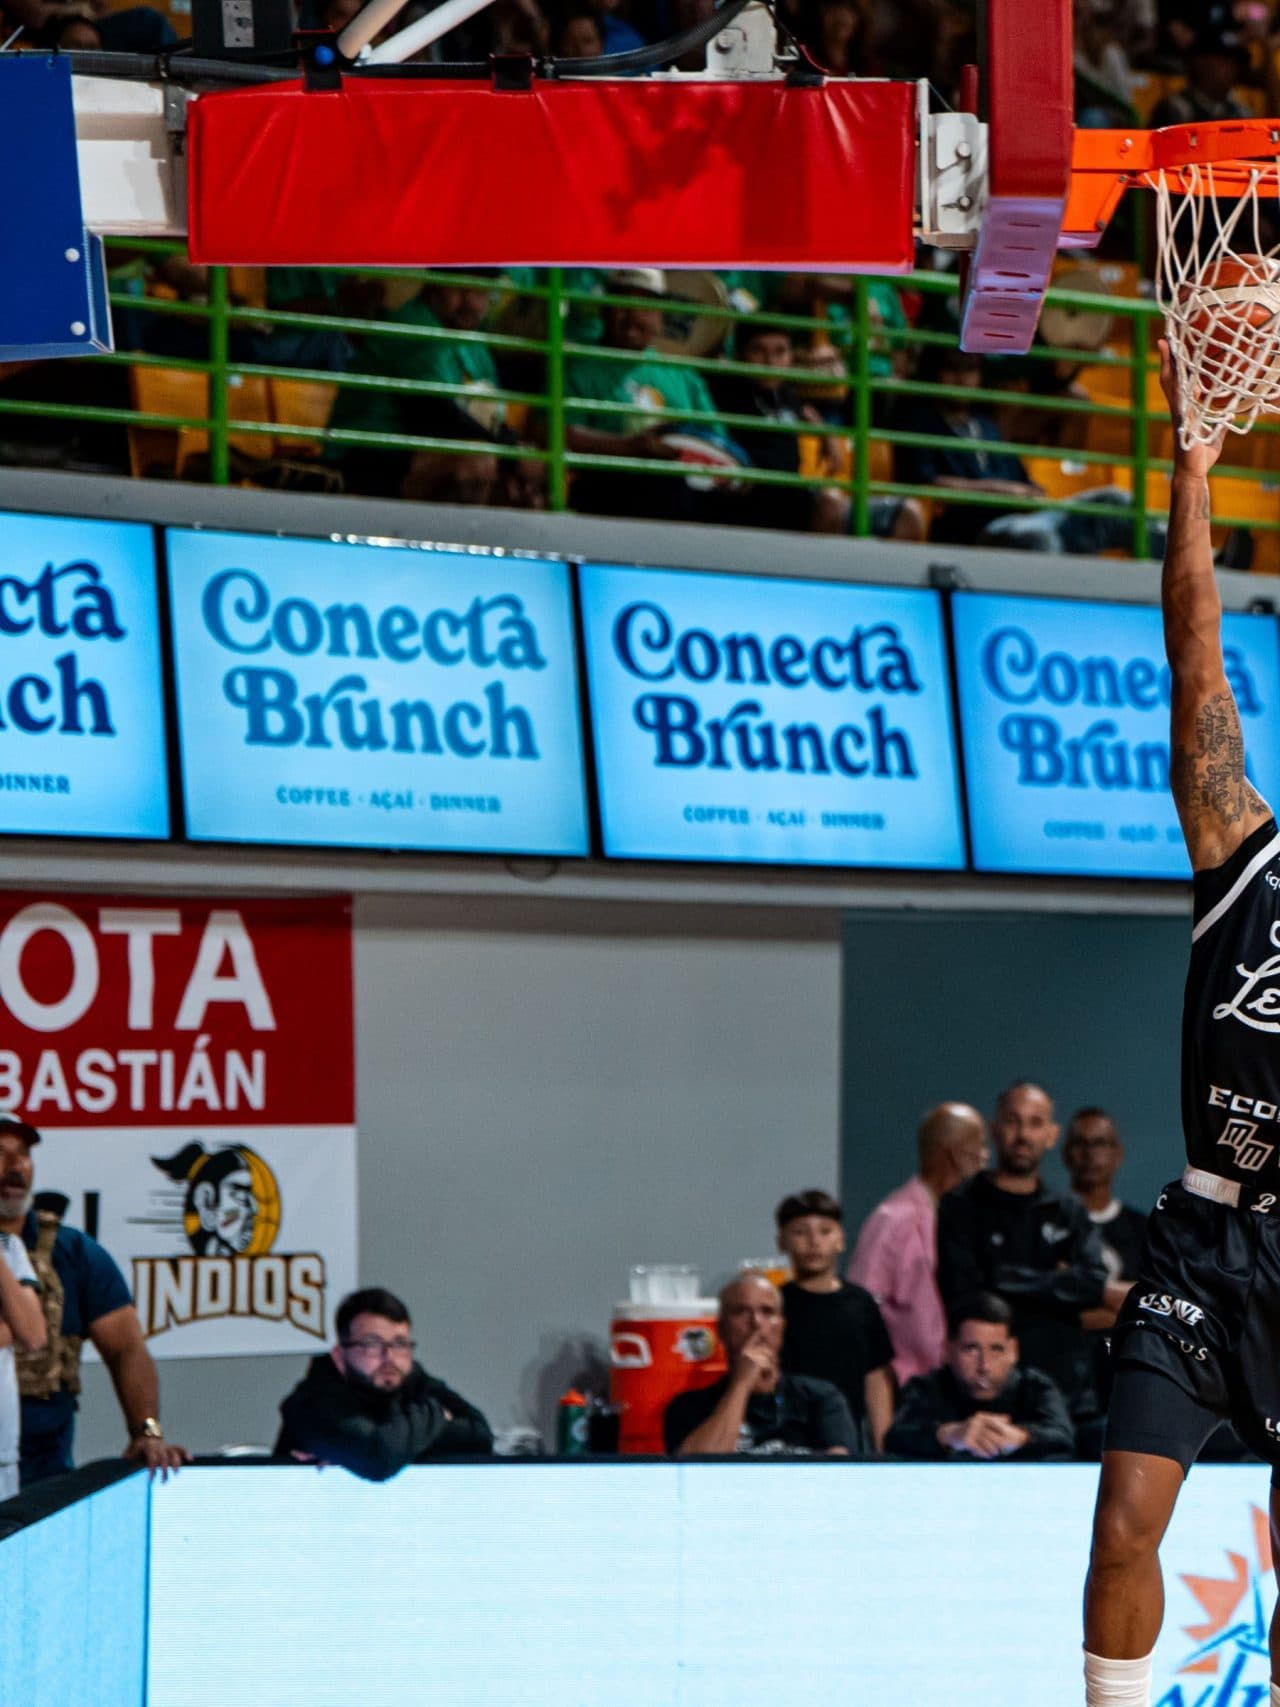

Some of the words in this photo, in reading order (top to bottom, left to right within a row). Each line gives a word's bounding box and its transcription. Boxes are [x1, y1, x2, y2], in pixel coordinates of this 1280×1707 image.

[201, 568, 547, 671] Conecta
[613, 602, 923, 695] Conecta
[0, 650, 117, 737] ch
[223, 666, 540, 761] Brunch
[981, 625, 1263, 717] Conea
[634, 692, 917, 780] Brunch
[1003, 714, 1171, 792] Brun
[276, 785, 350, 807] COFFEE
[430, 794, 501, 813] DINNER
[0, 901, 277, 1032] OTA
[132, 1251, 327, 1342] INDIOS
